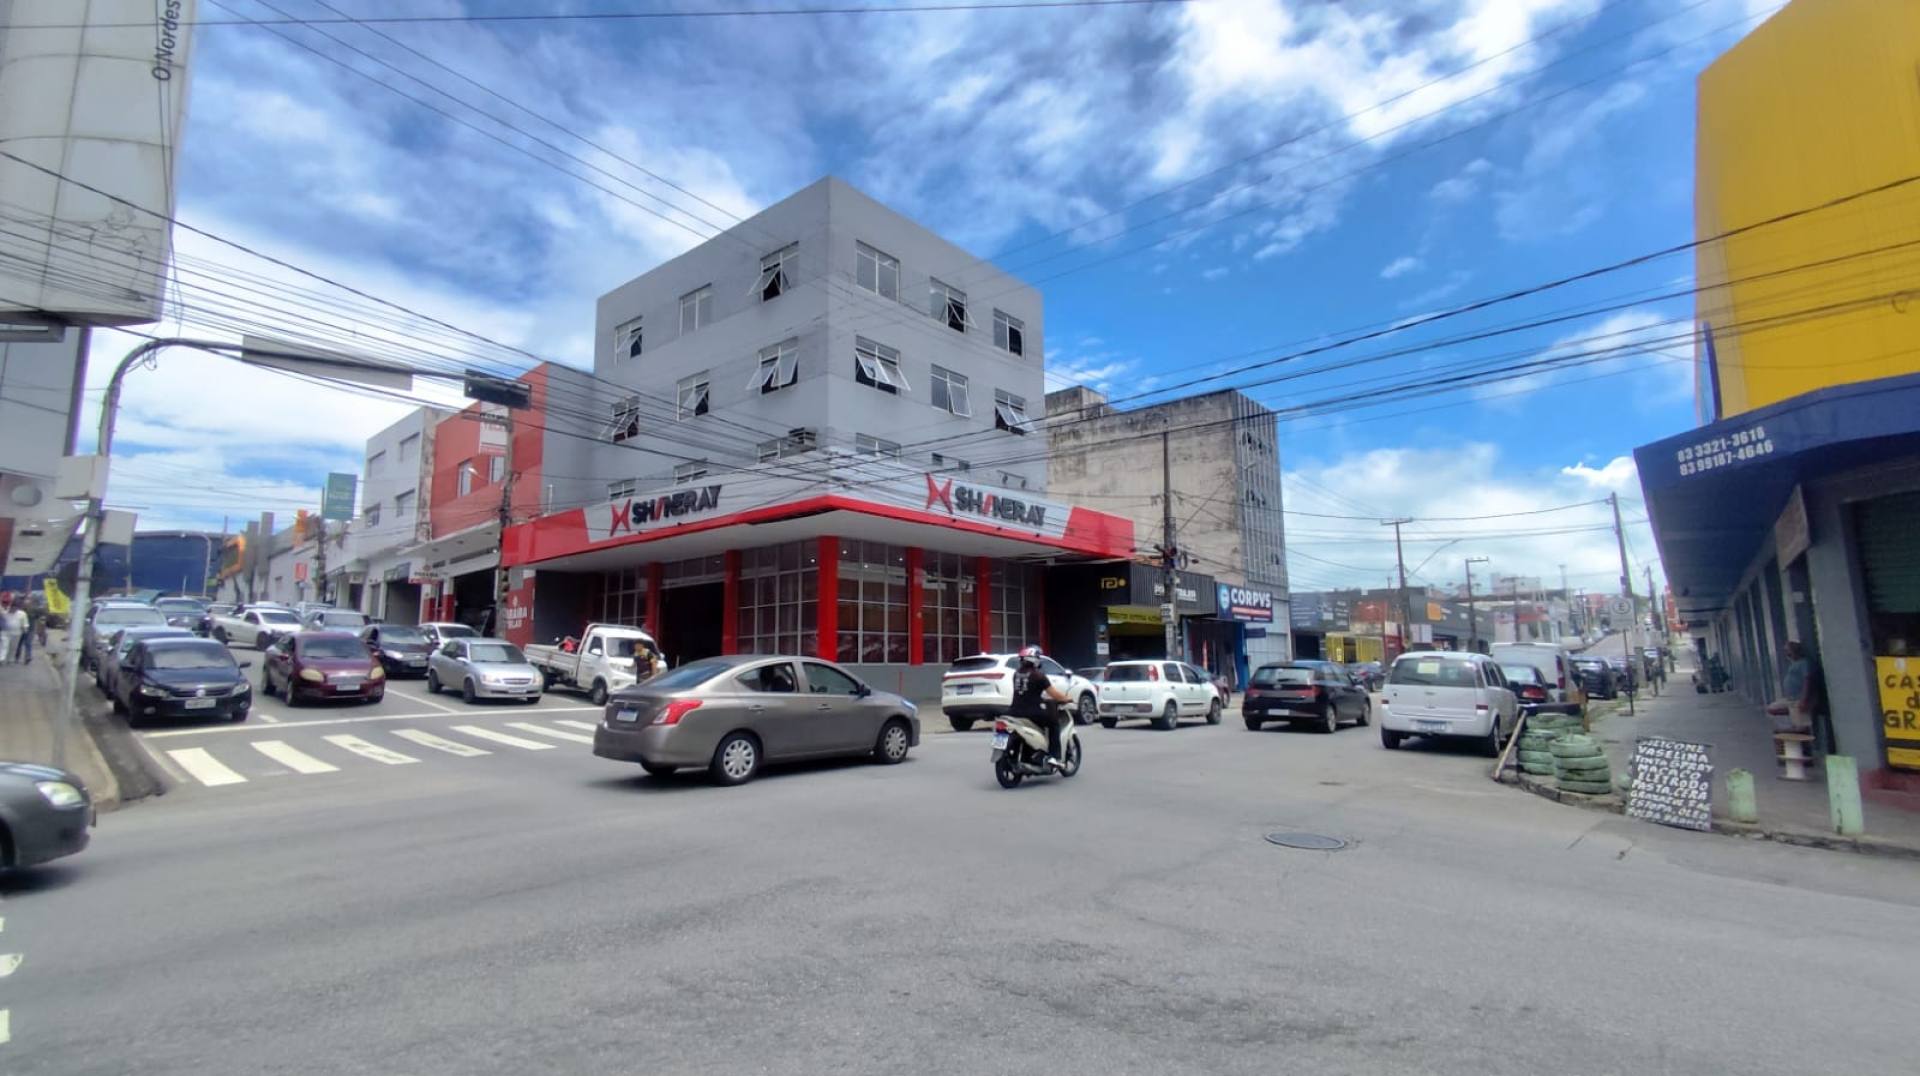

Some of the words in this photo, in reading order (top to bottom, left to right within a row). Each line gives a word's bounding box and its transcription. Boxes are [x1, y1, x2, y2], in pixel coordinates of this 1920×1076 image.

[152, 66, 171, 81] O
[1678, 447, 1694, 463] 83
[1680, 462, 1696, 477] 83
[632, 484, 722, 525] SHINERAY
[955, 486, 1046, 527] SHINERAY
[1231, 587, 1271, 609] CORPVS
[1884, 674, 1920, 689] CA
[1885, 709, 1920, 729] GR
[1638, 745, 1708, 763] VASELINA
[1637, 763, 1701, 780] MACACO
[1638, 772, 1709, 791] ELETRODO
